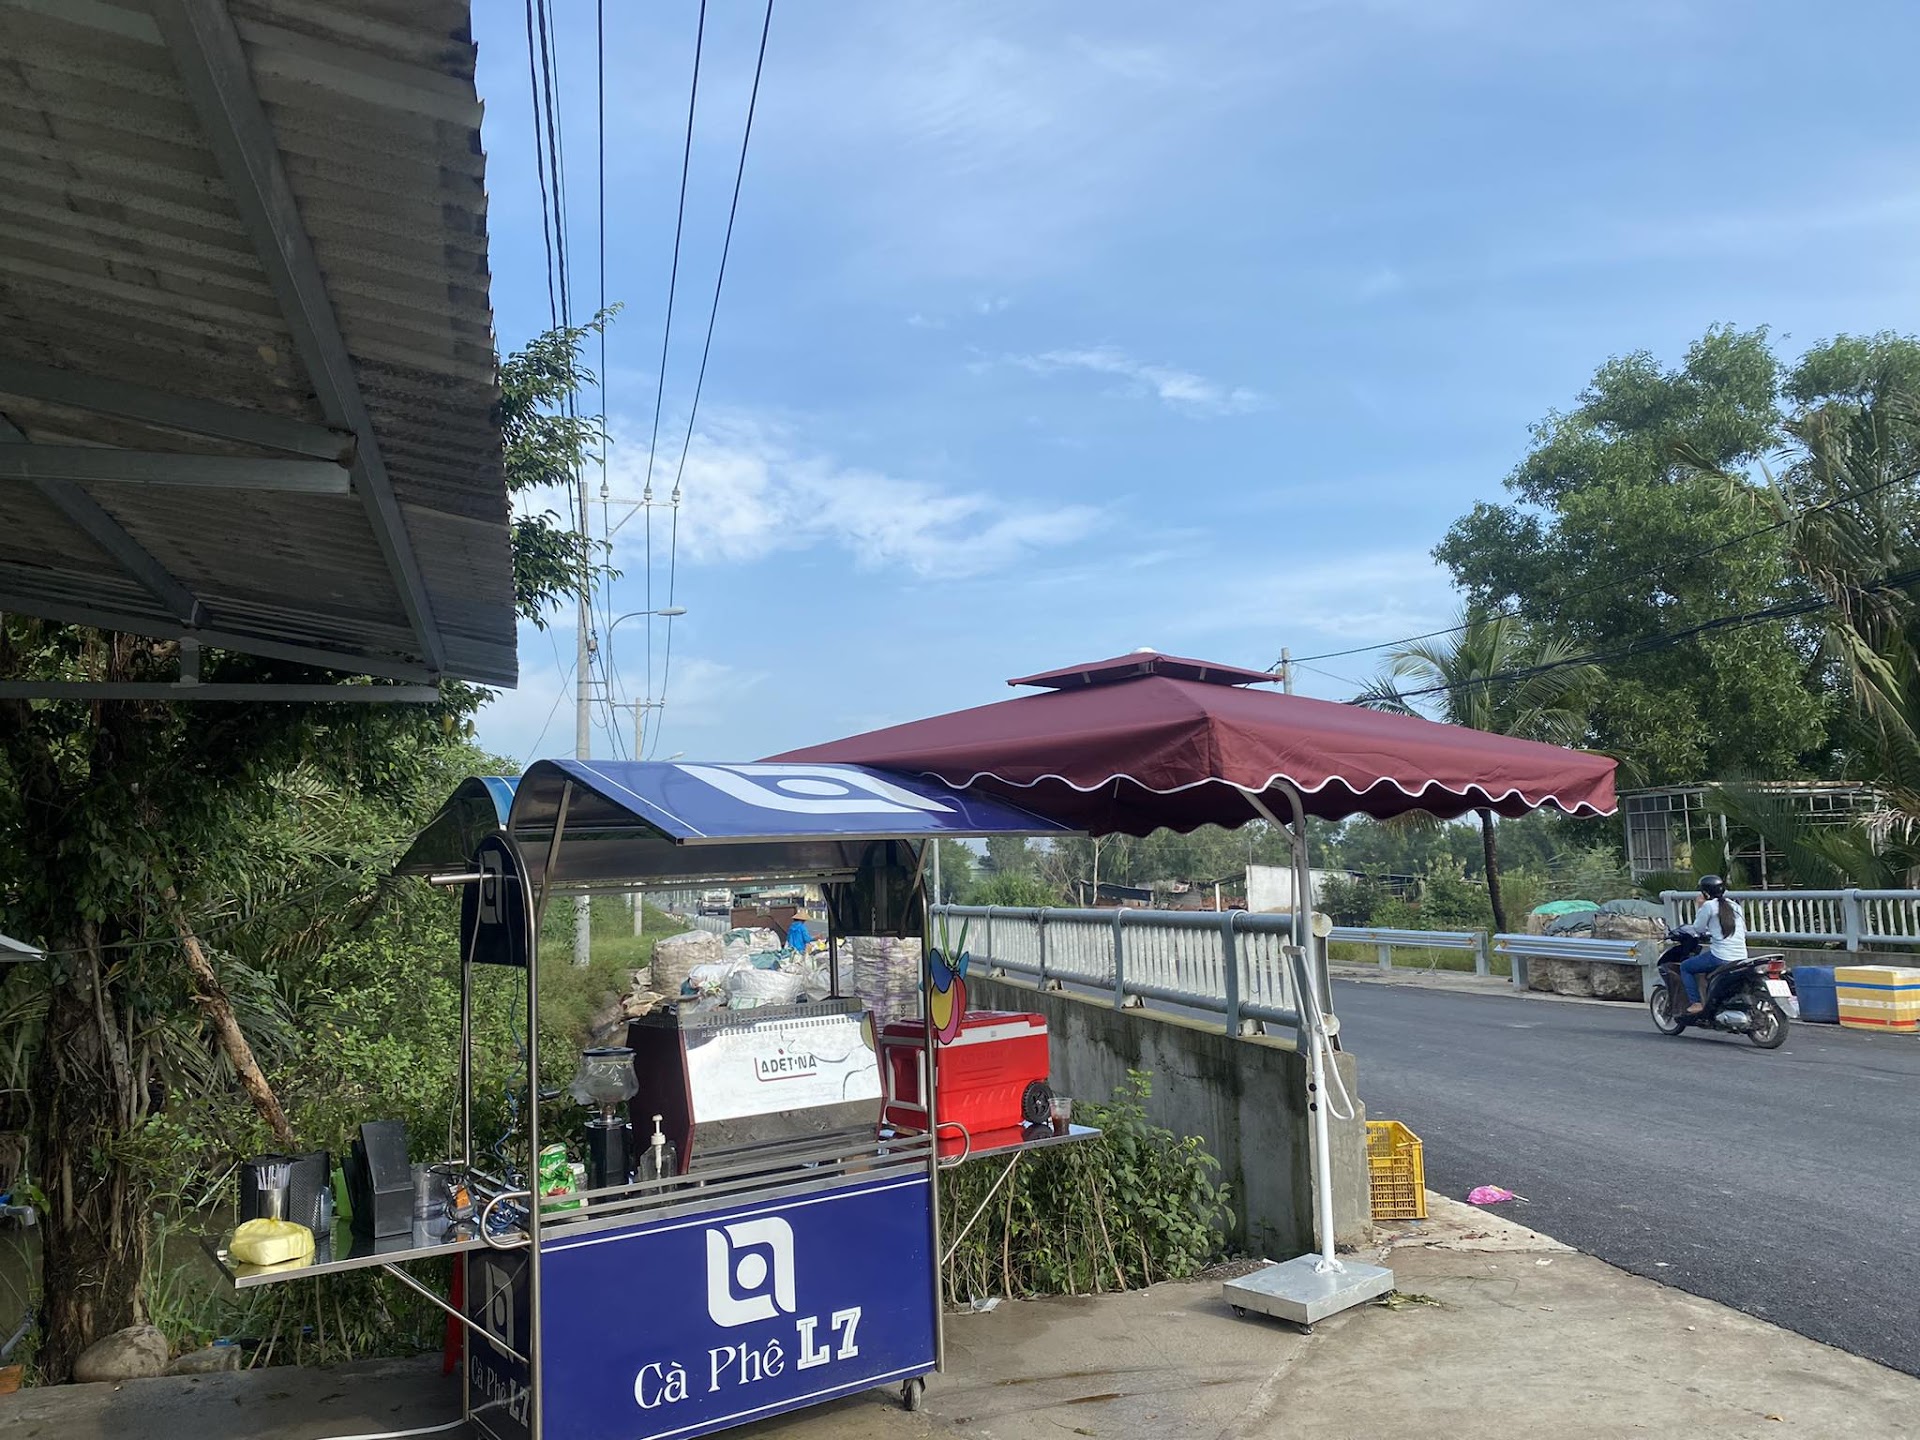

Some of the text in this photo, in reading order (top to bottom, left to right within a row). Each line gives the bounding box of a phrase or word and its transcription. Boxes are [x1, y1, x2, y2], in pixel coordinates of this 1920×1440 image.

[472, 1355, 483, 1390] Cà
[486, 1366, 507, 1409] Phê
[633, 1305, 862, 1409] Cà Phê L7
